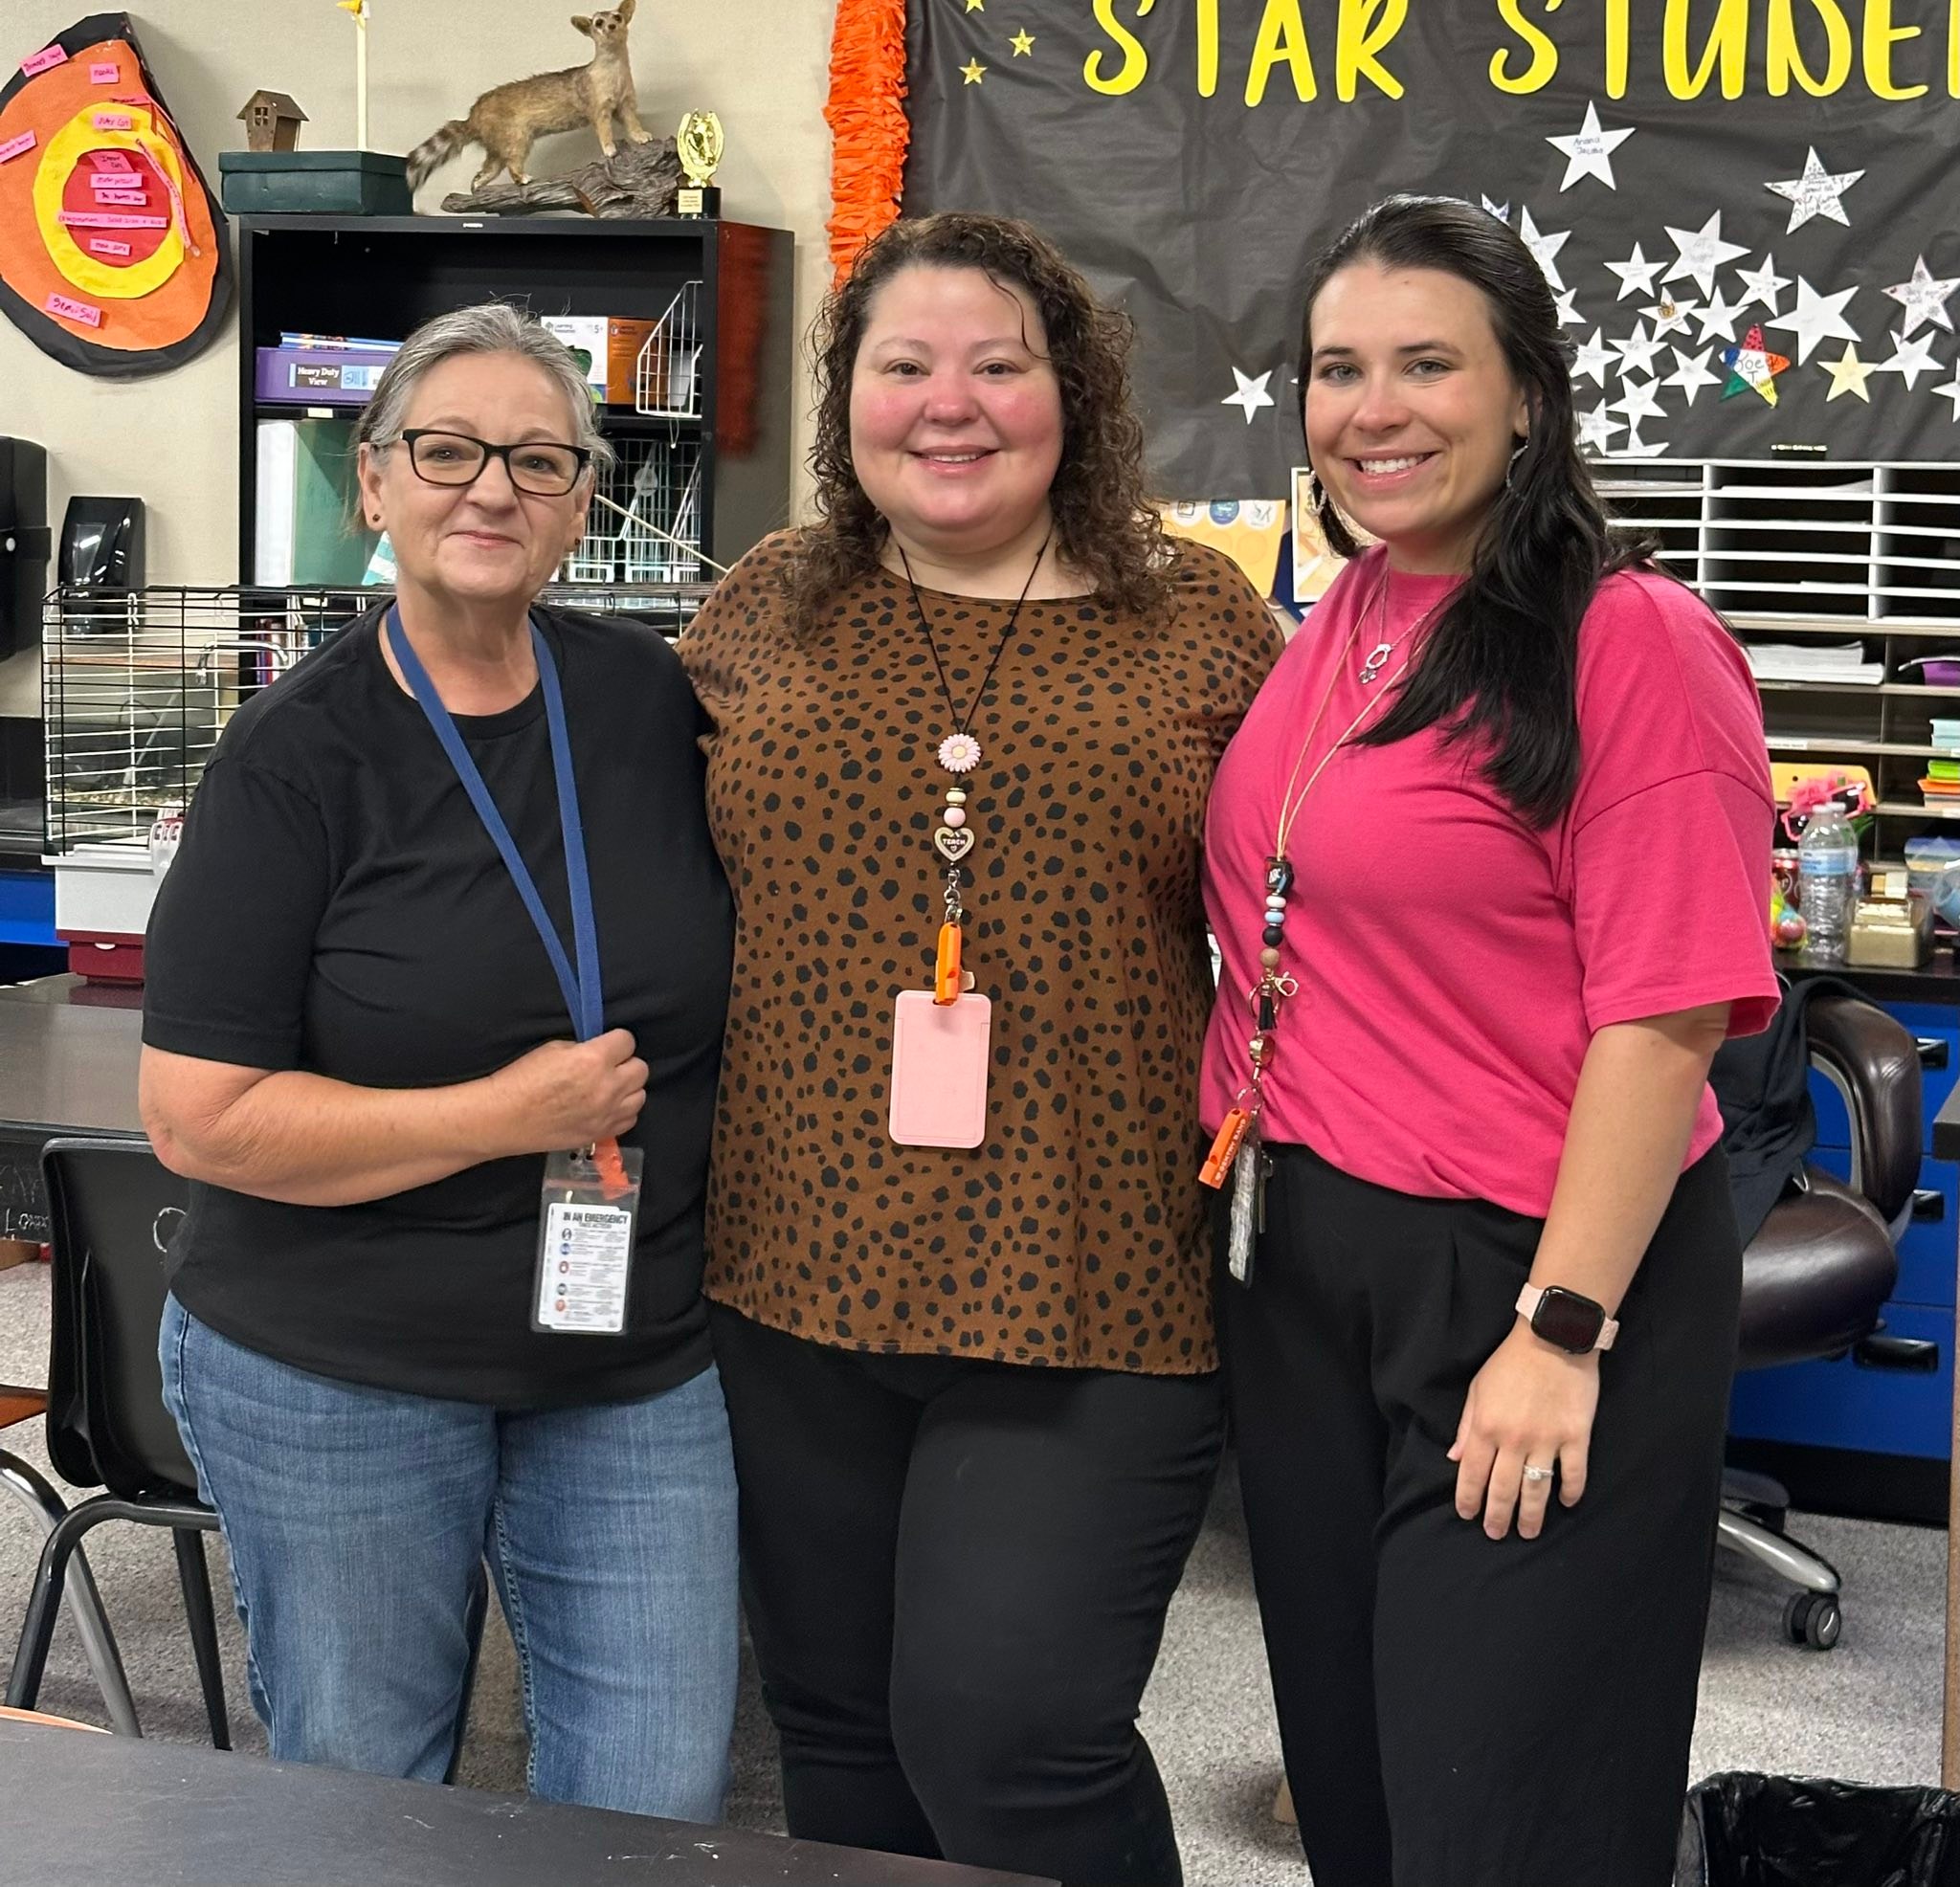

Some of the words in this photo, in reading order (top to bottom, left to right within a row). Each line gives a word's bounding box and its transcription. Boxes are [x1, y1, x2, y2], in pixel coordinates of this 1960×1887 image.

[1082, 0, 1405, 108] STAR
[1488, 0, 1960, 100] STUDE
[298, 367, 321, 377] Heavy
[321, 367, 340, 378] Duty
[308, 377, 328, 386] View
[585, 1213, 629, 1224] EMERGENCY
